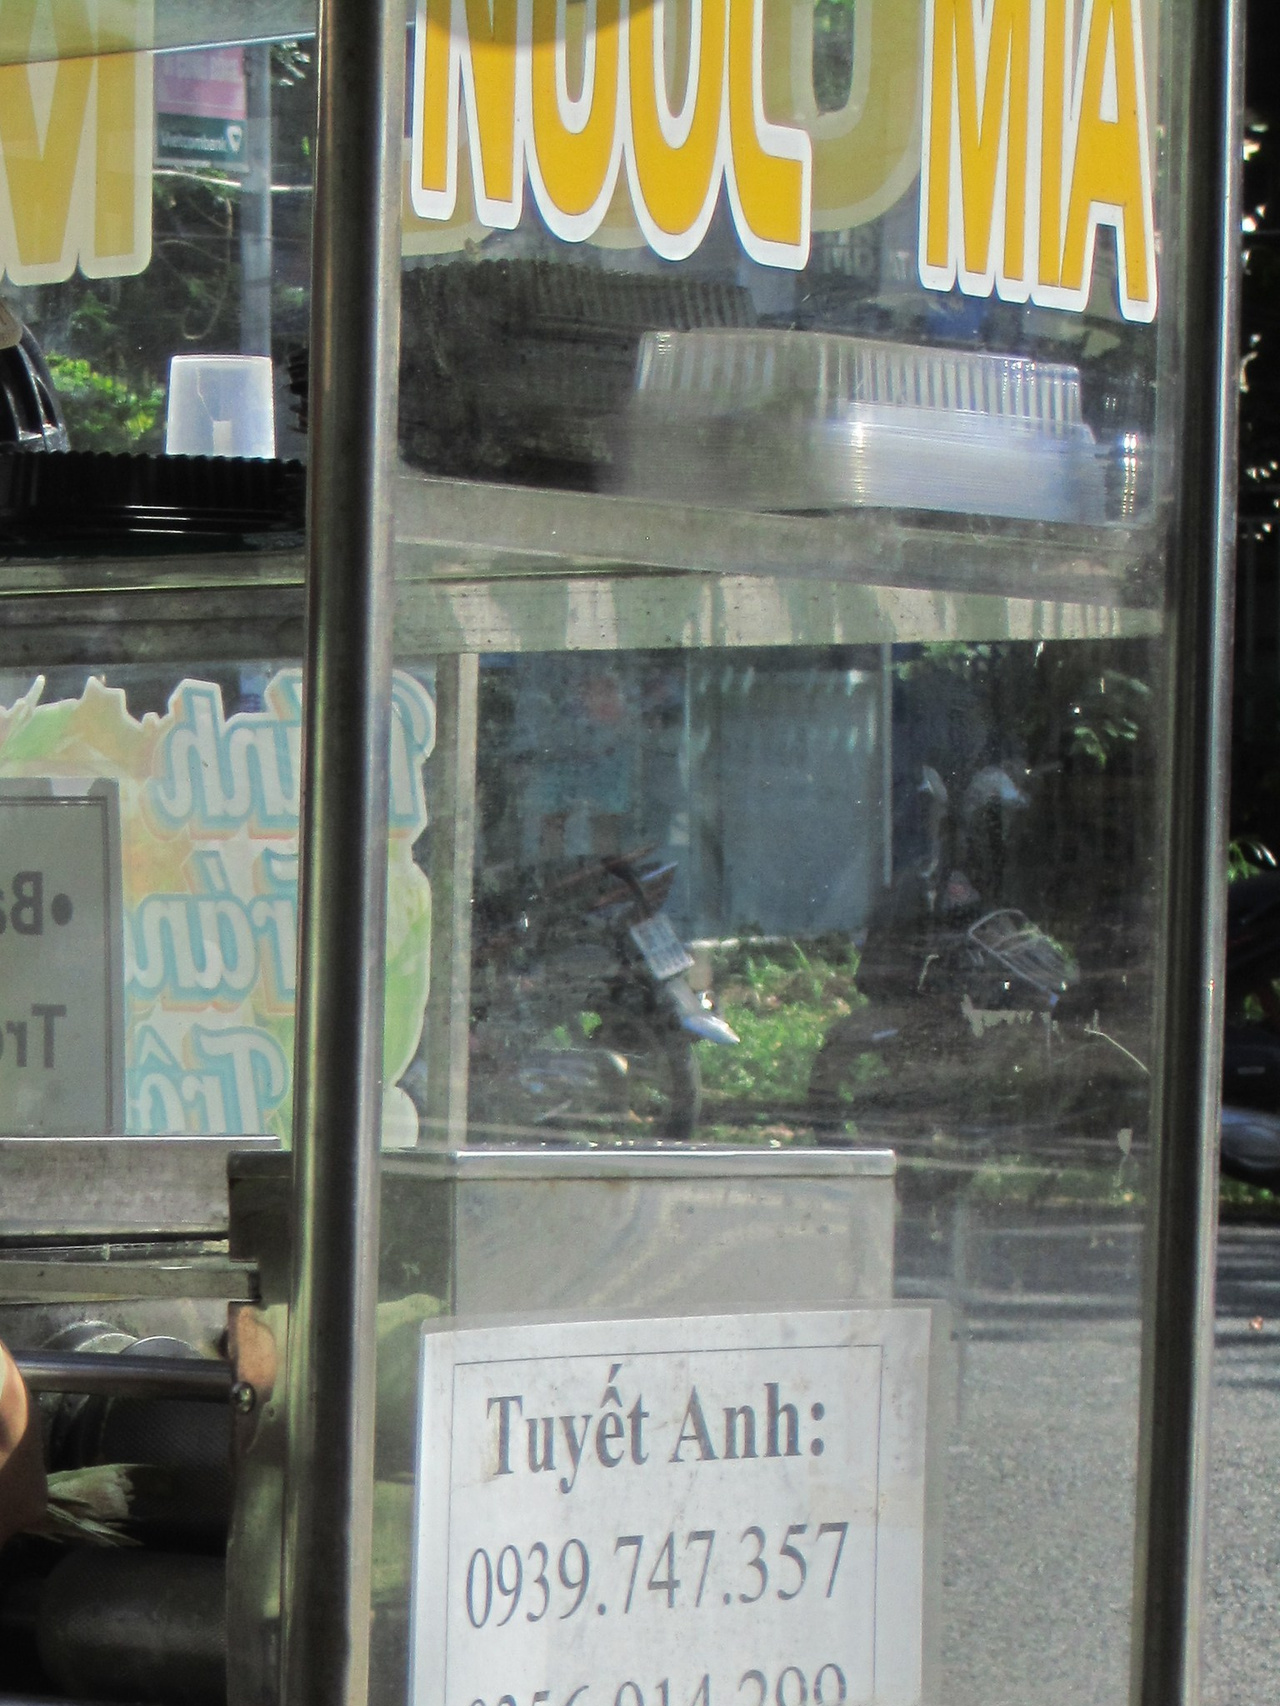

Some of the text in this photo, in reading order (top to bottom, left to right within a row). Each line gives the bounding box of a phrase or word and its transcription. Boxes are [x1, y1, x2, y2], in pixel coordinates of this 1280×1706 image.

[486, 1363, 827, 1494] Tuyết Anh:
[465, 1521, 849, 1630] 0939.747.357
